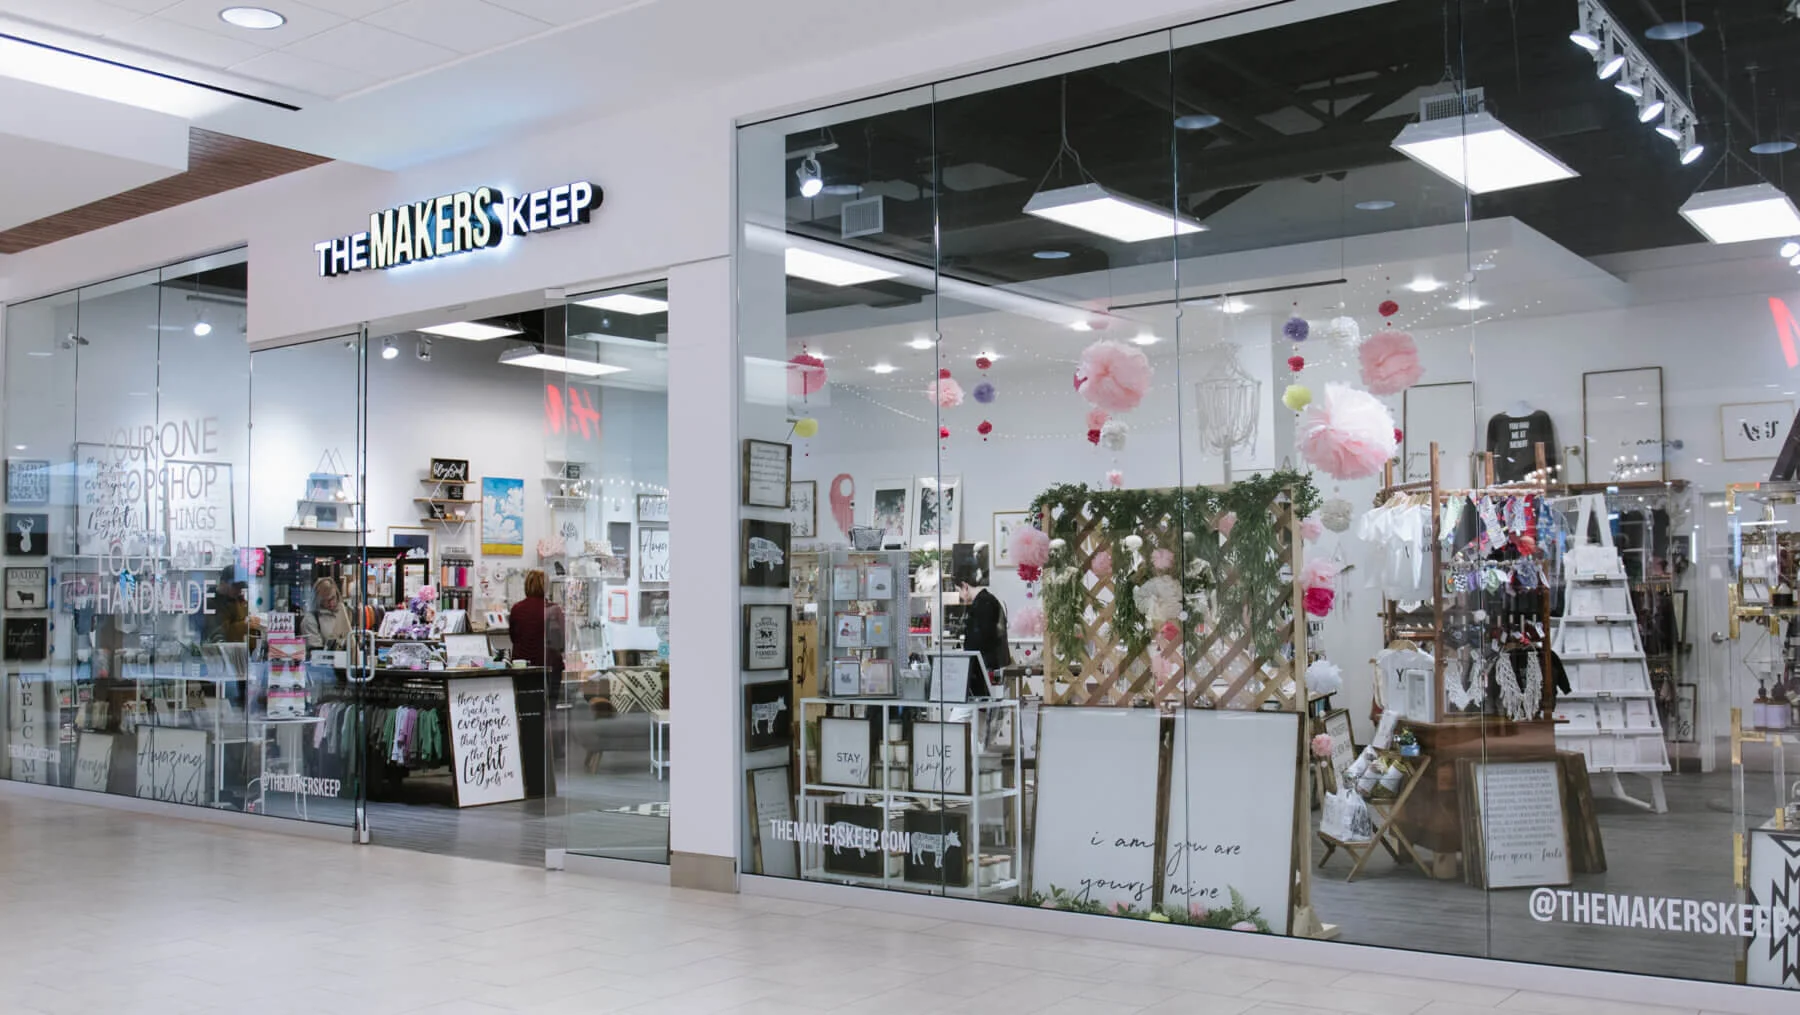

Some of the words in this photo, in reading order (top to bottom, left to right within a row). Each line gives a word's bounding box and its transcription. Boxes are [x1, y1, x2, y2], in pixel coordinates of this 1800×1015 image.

[314, 231, 371, 276] THE
[370, 186, 500, 269] MAKERS
[507, 180, 598, 235] KEEP
[160, 416, 218, 458] ONE
[158, 463, 218, 501] SHOP
[98, 540, 167, 577] LOCAL
[175, 539, 217, 569] AND
[97, 580, 217, 615] HANDMADE
[460, 733, 477, 747] that
[490, 729, 510, 745] how
[926, 744, 952, 758] LIVE
[470, 748, 484, 761] the
[836, 752, 862, 763] STAY
[260, 772, 341, 797] @THEMAKERSKEEP
[769, 819, 910, 854] THEMAKERSKEEP.COM
[1090, 831, 1105, 846] i
[1115, 837, 1156, 848] am
[1214, 844, 1242, 855] are
[1074, 877, 1154, 906] yours
[1169, 880, 1220, 899] mine
[1529, 887, 1790, 939] @THEMAKERSKEEP
